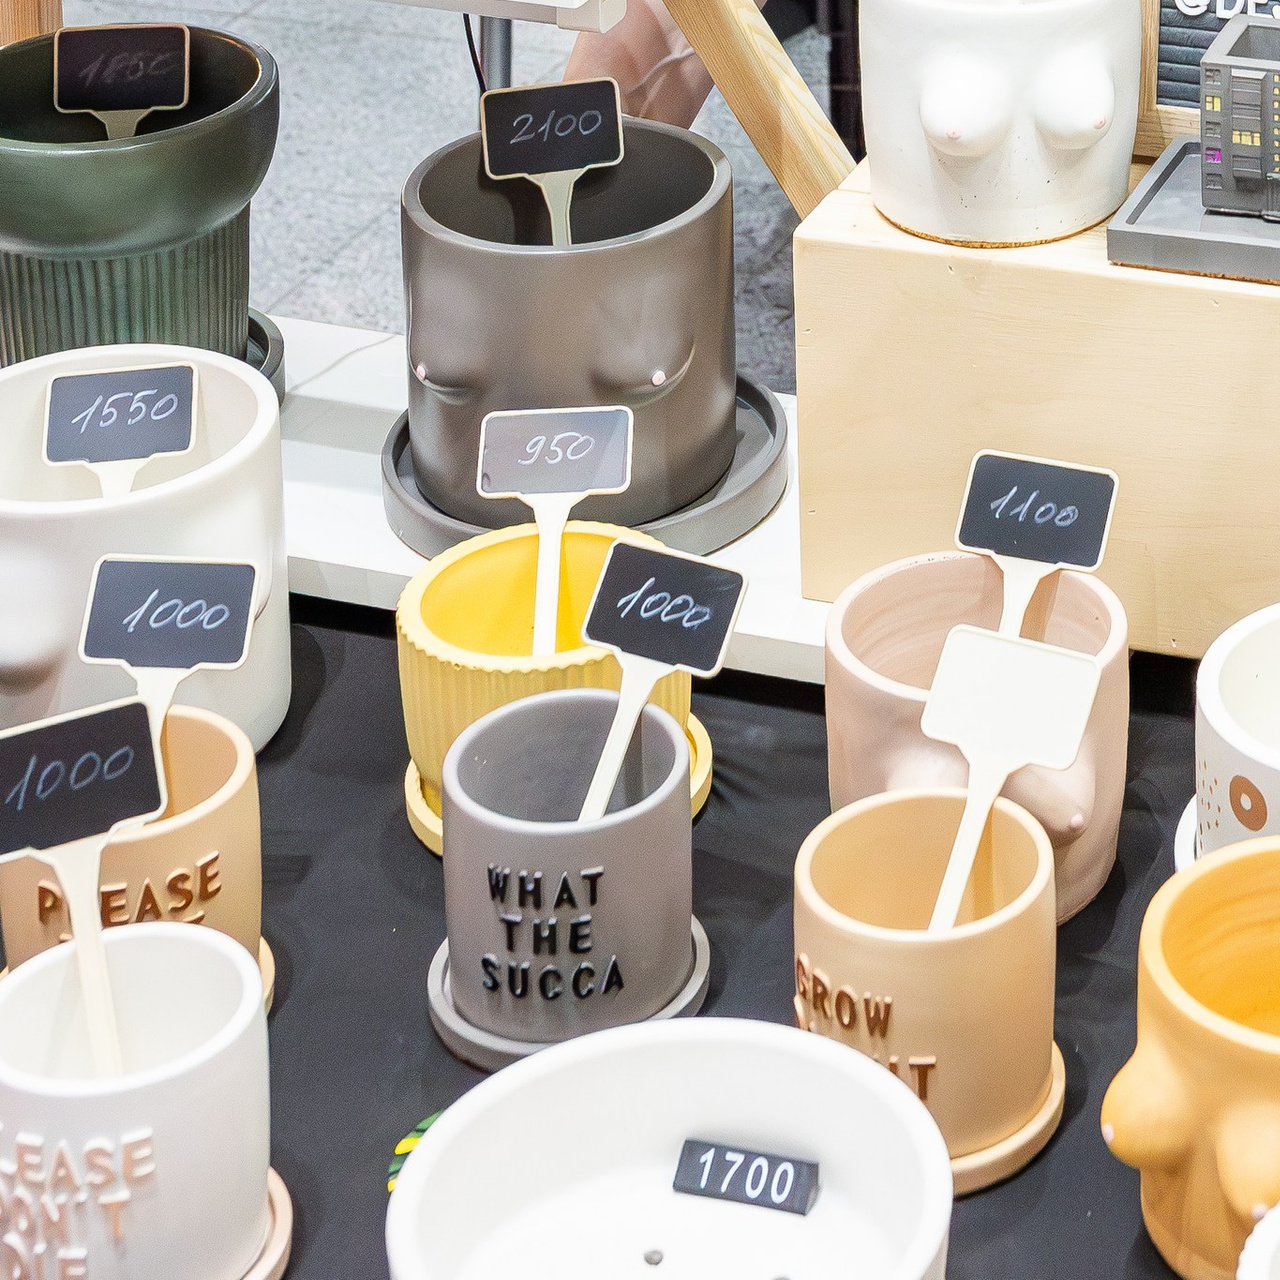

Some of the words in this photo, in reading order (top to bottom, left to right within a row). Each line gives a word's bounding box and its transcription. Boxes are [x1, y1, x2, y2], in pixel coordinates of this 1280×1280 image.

[510, 109, 602, 145] 2100
[72, 389, 179, 434] 1550
[517, 431, 596, 466] 950
[990, 485, 1079, 527] 1100
[122, 588, 231, 634] 1000
[616, 576, 712, 630] 1000
[5, 745, 135, 812] 1000
[38, 850, 223, 930] PEASE
[486, 862, 605, 910] WHAT
[500, 913, 595, 956] THE
[480, 952, 625, 1001] SUCCA
[699, 1147, 795, 1204] 1700
